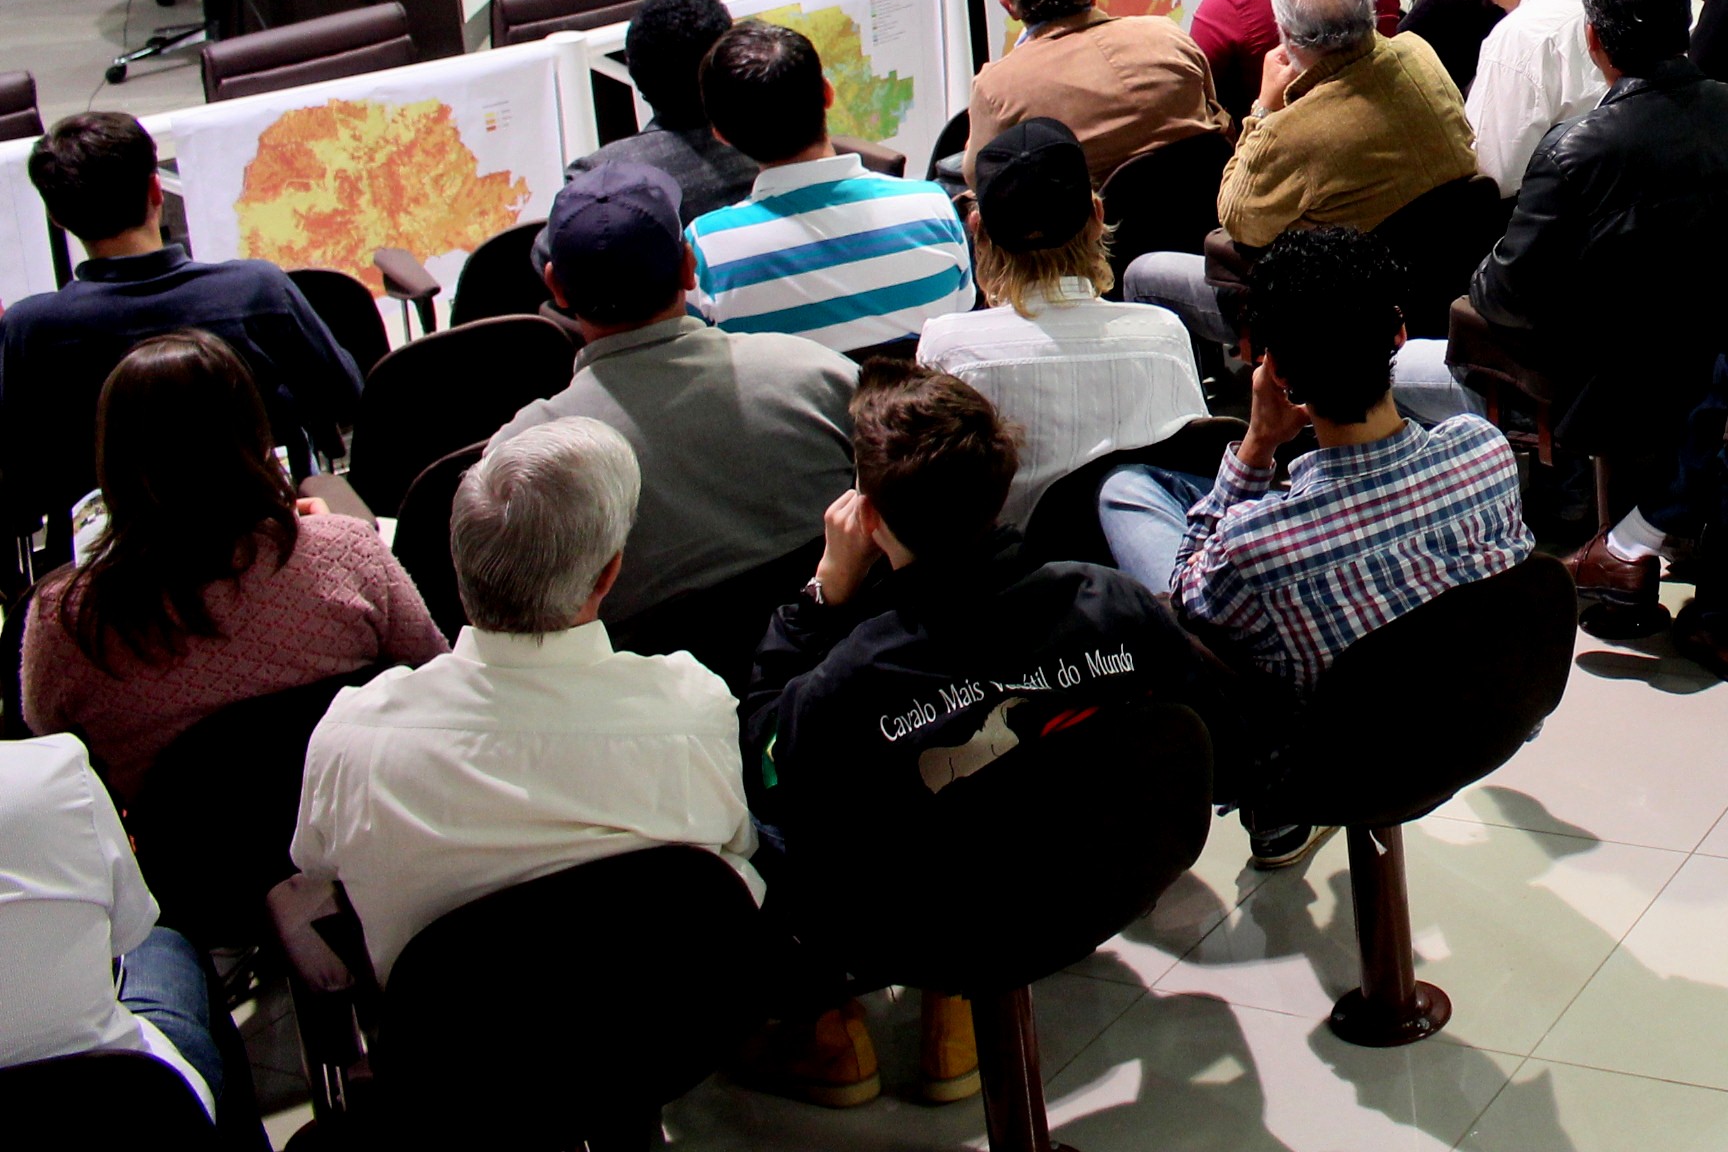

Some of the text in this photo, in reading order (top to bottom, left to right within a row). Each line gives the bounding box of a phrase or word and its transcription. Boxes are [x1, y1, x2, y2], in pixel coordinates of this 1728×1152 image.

[879, 699, 937, 742] Cavalo
[938, 679, 985, 714] Mais
[1057, 658, 1081, 689] do
